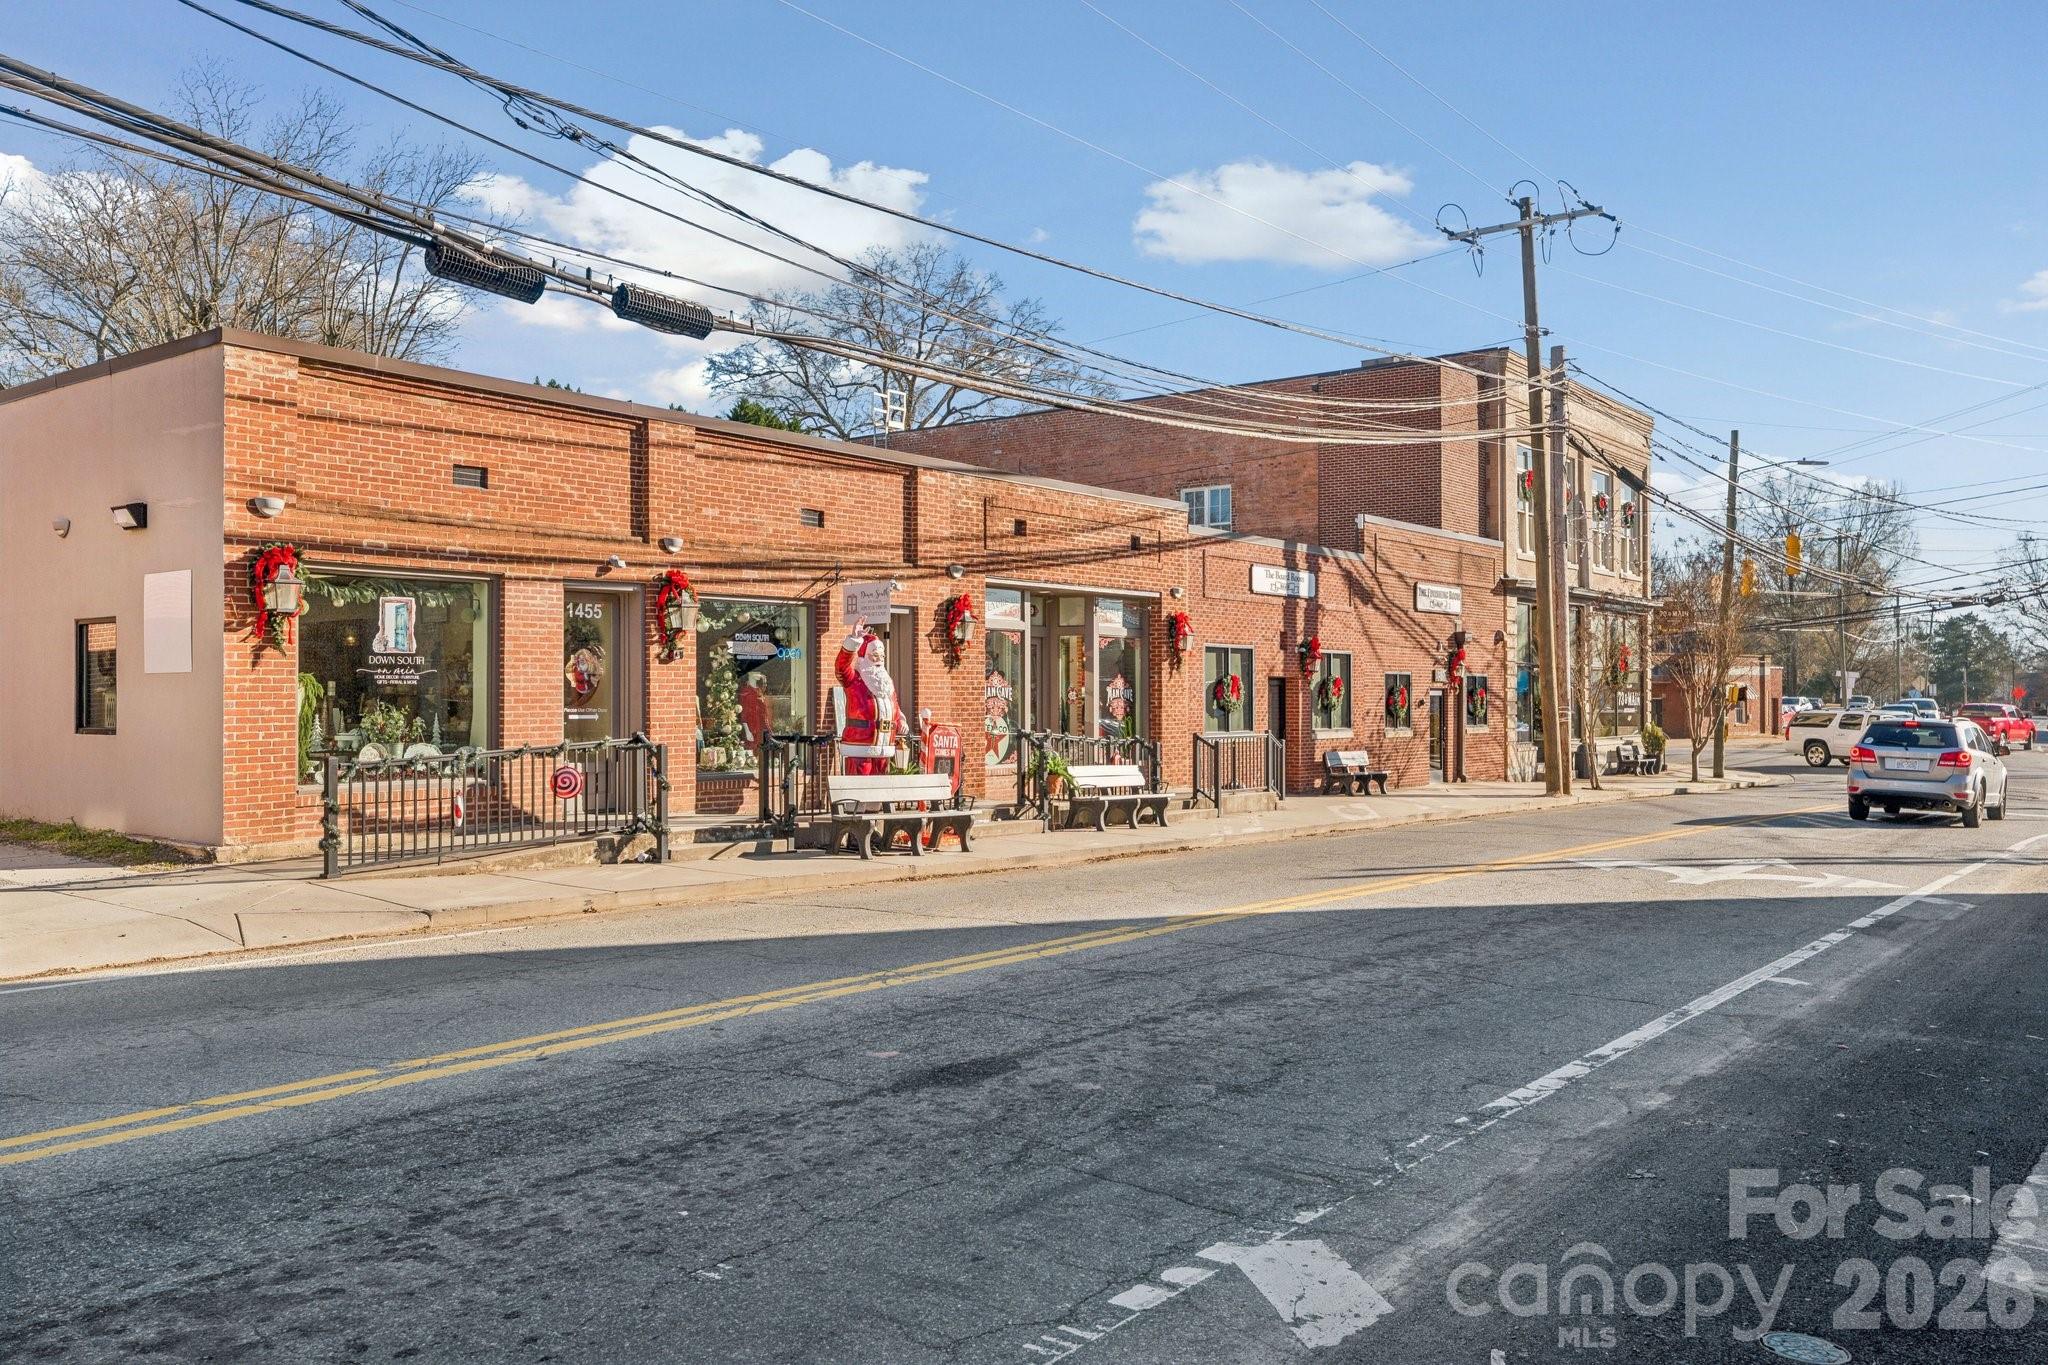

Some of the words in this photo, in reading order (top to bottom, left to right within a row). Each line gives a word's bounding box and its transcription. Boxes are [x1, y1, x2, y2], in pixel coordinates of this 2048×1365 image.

[566, 602, 603, 619] 1455
[368, 655, 395, 664] DOWN
[397, 656, 425, 665] SOUTH
[933, 734, 958, 748] SANTA
